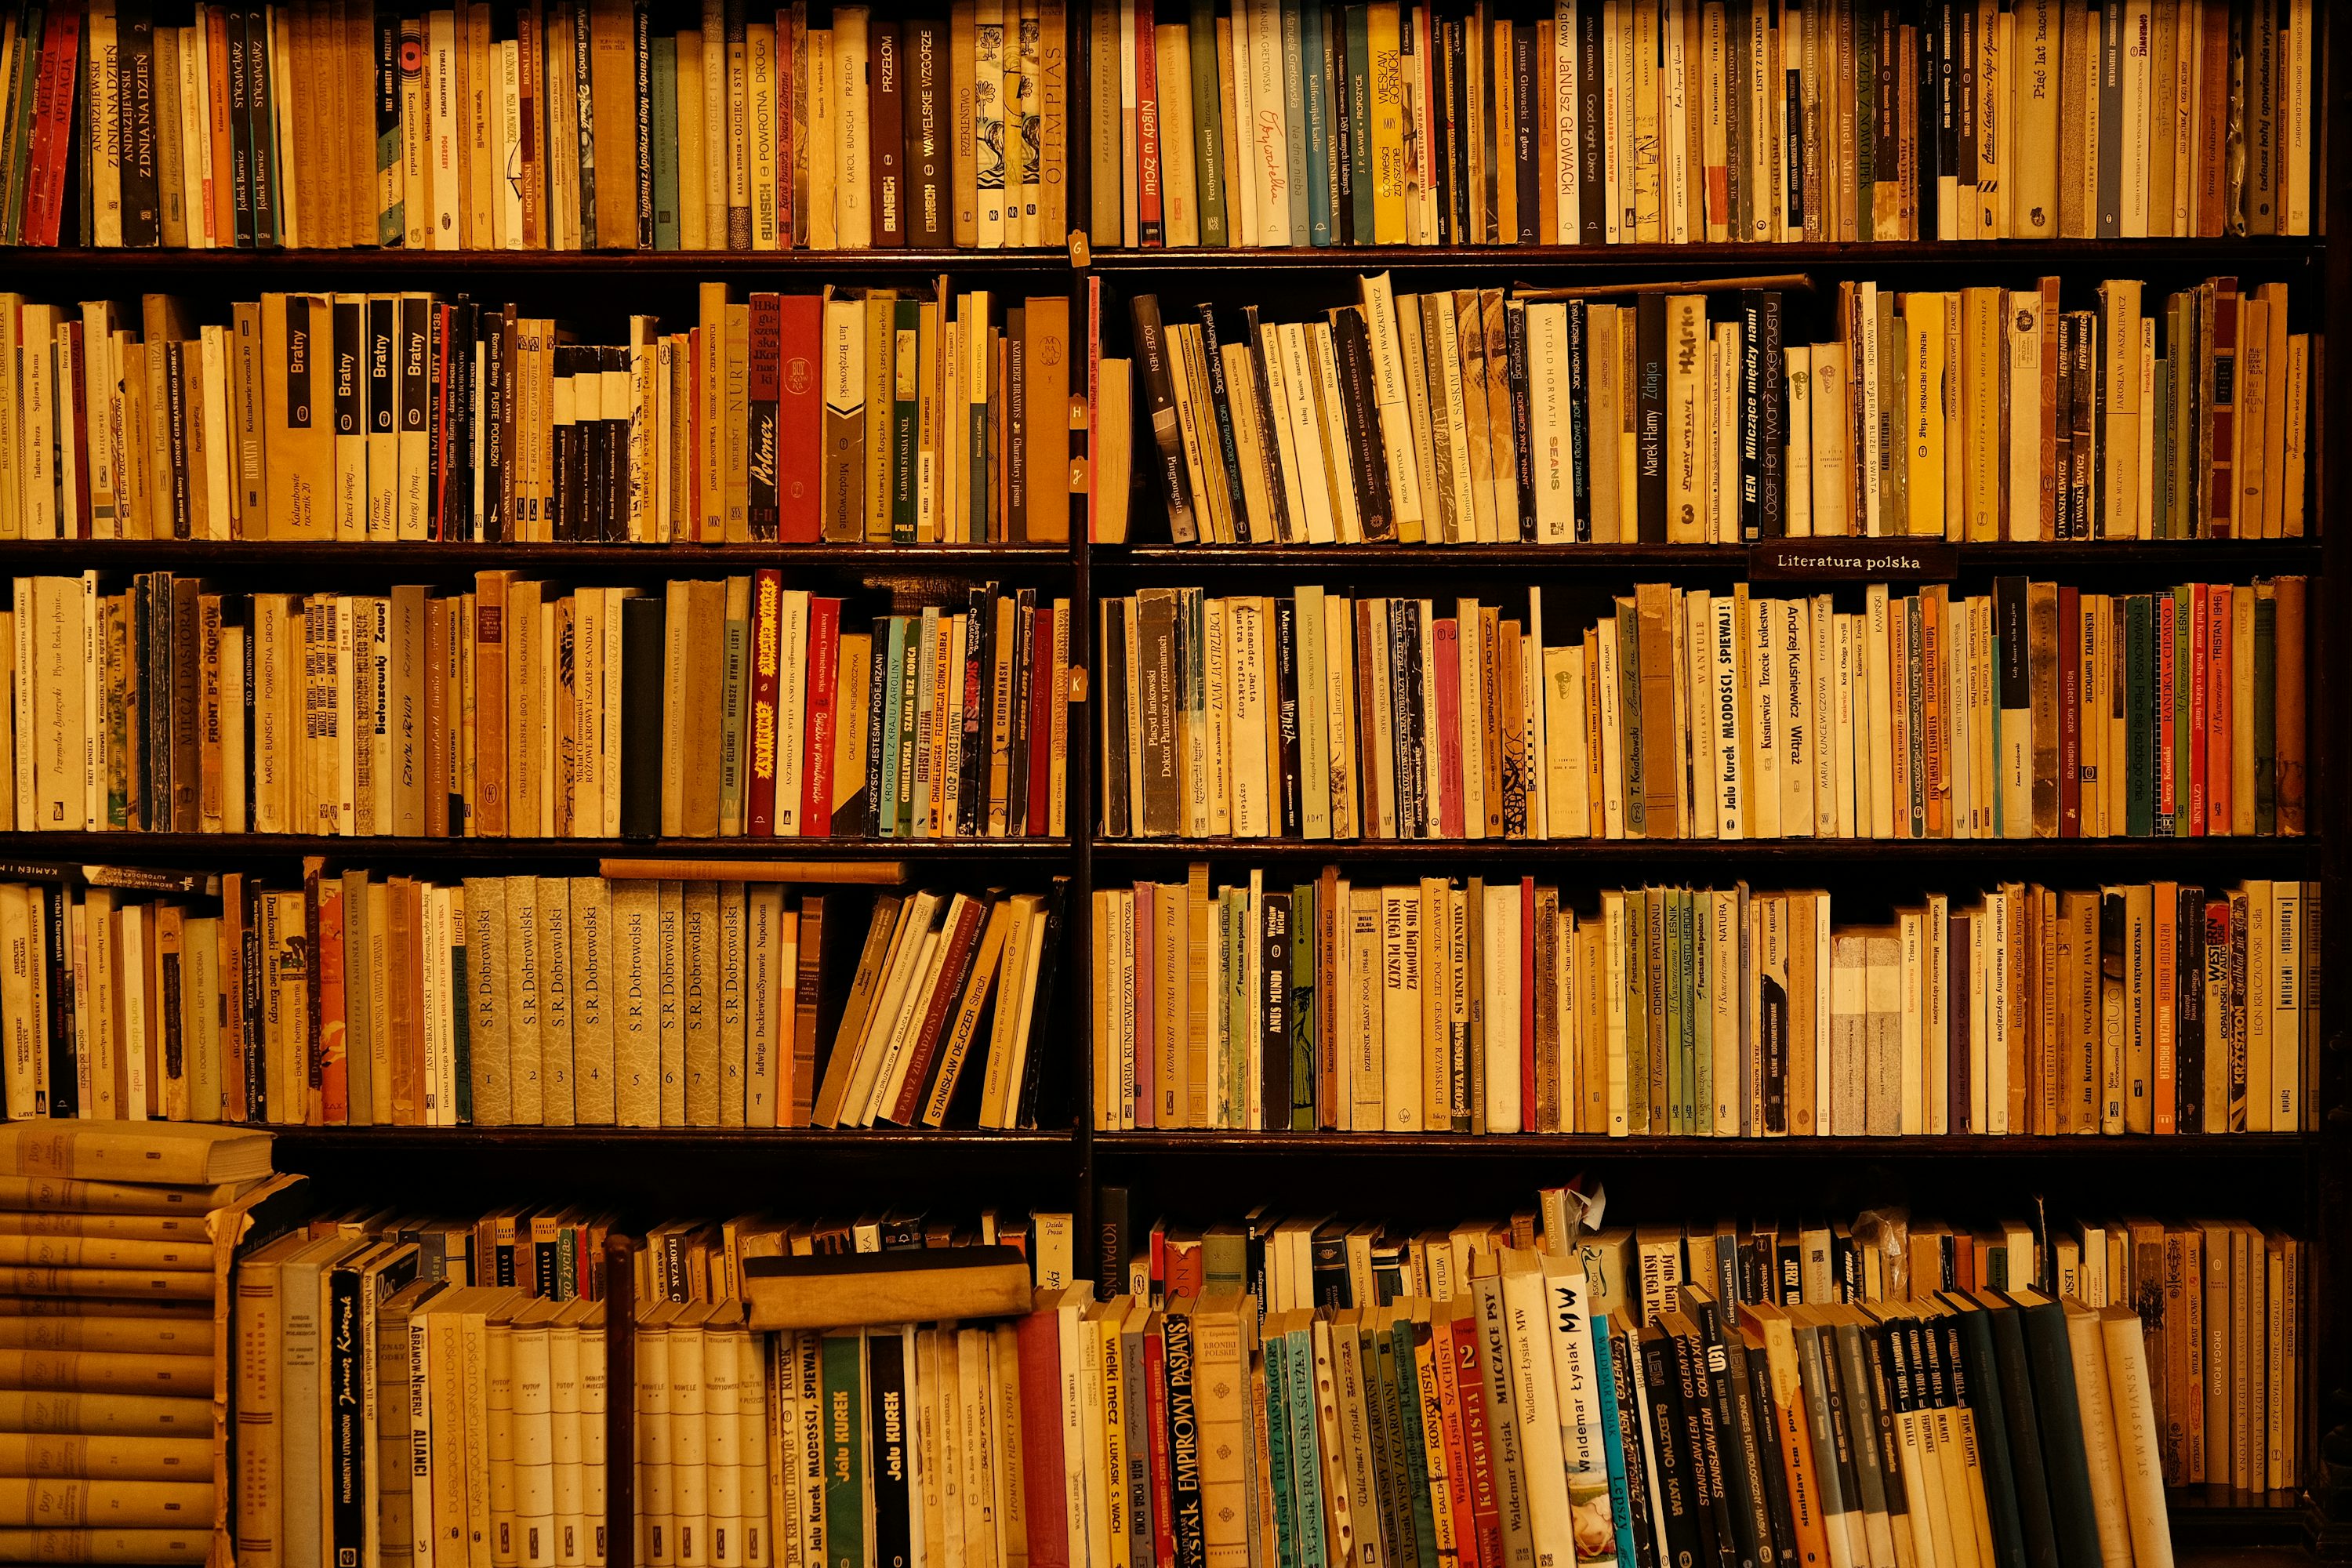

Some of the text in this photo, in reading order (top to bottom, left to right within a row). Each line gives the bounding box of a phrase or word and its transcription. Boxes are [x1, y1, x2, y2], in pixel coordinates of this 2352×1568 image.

[92, 60, 101, 152] ANDRZEJEWSKI
[105, 44, 118, 90] DZIEŃ
[108, 92, 117, 114] NA
[134, 24, 151, 177] Z DNIA NA DZIEŃ 2
[1377, 50, 1388, 104] WIESŁAW
[108, 119, 118, 156] DNIA
[122, 70, 133, 162] ANDRZEJEWSKI
[755, 38, 772, 240] BUNSCH POWROTNA DROGA
[881, 36, 895, 232] BUNSCH PRZEŁOM
[920, 30, 937, 232] BUNSCH WAWELSKIE WZGÓRZE
[1045, 47, 1062, 184] OLIMPIAS
[108, 157, 119, 168] Z
[236, 150, 248, 211] Jędrek Barwicz
[1204, 129, 1216, 201] Ferdynand Goetel
[1379, 147, 1402, 198] opowieści zdyszane
[291, 331, 306, 373] Bratny
[339, 354, 354, 396] Bratny
[374, 335, 390, 378] Bratny
[408, 332, 424, 376] Bratny
[1373, 288, 1396, 398] JAROSŁAW IWASZKIEWICZ
[32, 381, 41, 412] Spiżowa
[840, 325, 849, 528] Jan Brzękowski Międzywojnie
[1642, 361, 1662, 477] Marek Harny Zdrajca
[1745, 309, 1759, 503] HEN Milczące między nami
[750, 415, 774, 486] Polonez
[899, 467, 909, 502] ŚLADAMI
[1778, 555, 1921, 571] Literatura polska
[375, 602, 387, 735] Białoszewski Zawał
[584, 615, 593, 668] SCANDALIE
[1158, 635, 1169, 692] przemianach
[1759, 601, 1772, 749] Kuśniewicz Trzecie królestwo
[585, 707, 593, 741] KROWY
[869, 655, 883, 811] WSZYSCY JESTEŚMY PODEJRZANI
[902, 647, 916, 803] CHMIELEWSKA SZAJKA BEZ KOŃCA
[1146, 670, 1158, 746] Placyd Jankowski
[1160, 704, 1170, 743] Panteusz
[2162, 608, 2172, 805] Jerzy Kosiński RANDKA w CIEMNO
[583, 743, 593, 783] RÓŻOWE
[1161, 746, 1171, 777] Doktor
[1723, 746, 1735, 782] Kurek
[1724, 786, 1736, 810] Jalu
[520, 906, 536, 1024] S. R. Dobrowolski
[724, 906, 738, 1024] S. R. Dobrowolski
[1268, 906, 1285, 938] Wiesław Kielar
[1388, 899, 1401, 989] KSIĘGA PUSZCZY
[1406, 898, 1418, 989] Tytus Karpowicz
[628, 913, 641, 1031] S. R. Dobrowolski
[662, 911, 674, 1029] S. R. Dobrowolski
[1123, 901, 1133, 1098] MARIA KUNCEWICZOWA przeźrocza
[1270, 970, 1282, 1033] ANUS MUNDI
[2253, 909, 2263, 1036] LEON KRUCZKOWSKI Sidła
[529, 1071, 536, 1080] 2
[633, 1075, 639, 1086] 5
[666, 1072, 673, 1083] 6
[729, 1065, 735, 1077] 8
[931, 975, 988, 1118] STANISŁAW DEJCZER Strach
[1555, 1287, 1581, 1333] MW
[336, 1296, 357, 1504] FRAGMENTY UTWORÓW Janusz Korczak
[1167, 1322, 1196, 1491] EMPIROWY PASJANS
[1515, 1308, 1537, 1424] Waldemar Łysiak MW
[1566, 1342, 1591, 1472] Waldemar Łysiak
[833, 1391, 851, 1483] Jalu KUREK
[884, 1392, 902, 1481] Jalu KUREK
[1485, 1292, 1523, 1532] Waldemar Łysiak MILCZĄCE PSY
[1675, 1338, 1710, 1506] STANISŁAW LEM GOLEM XIV
